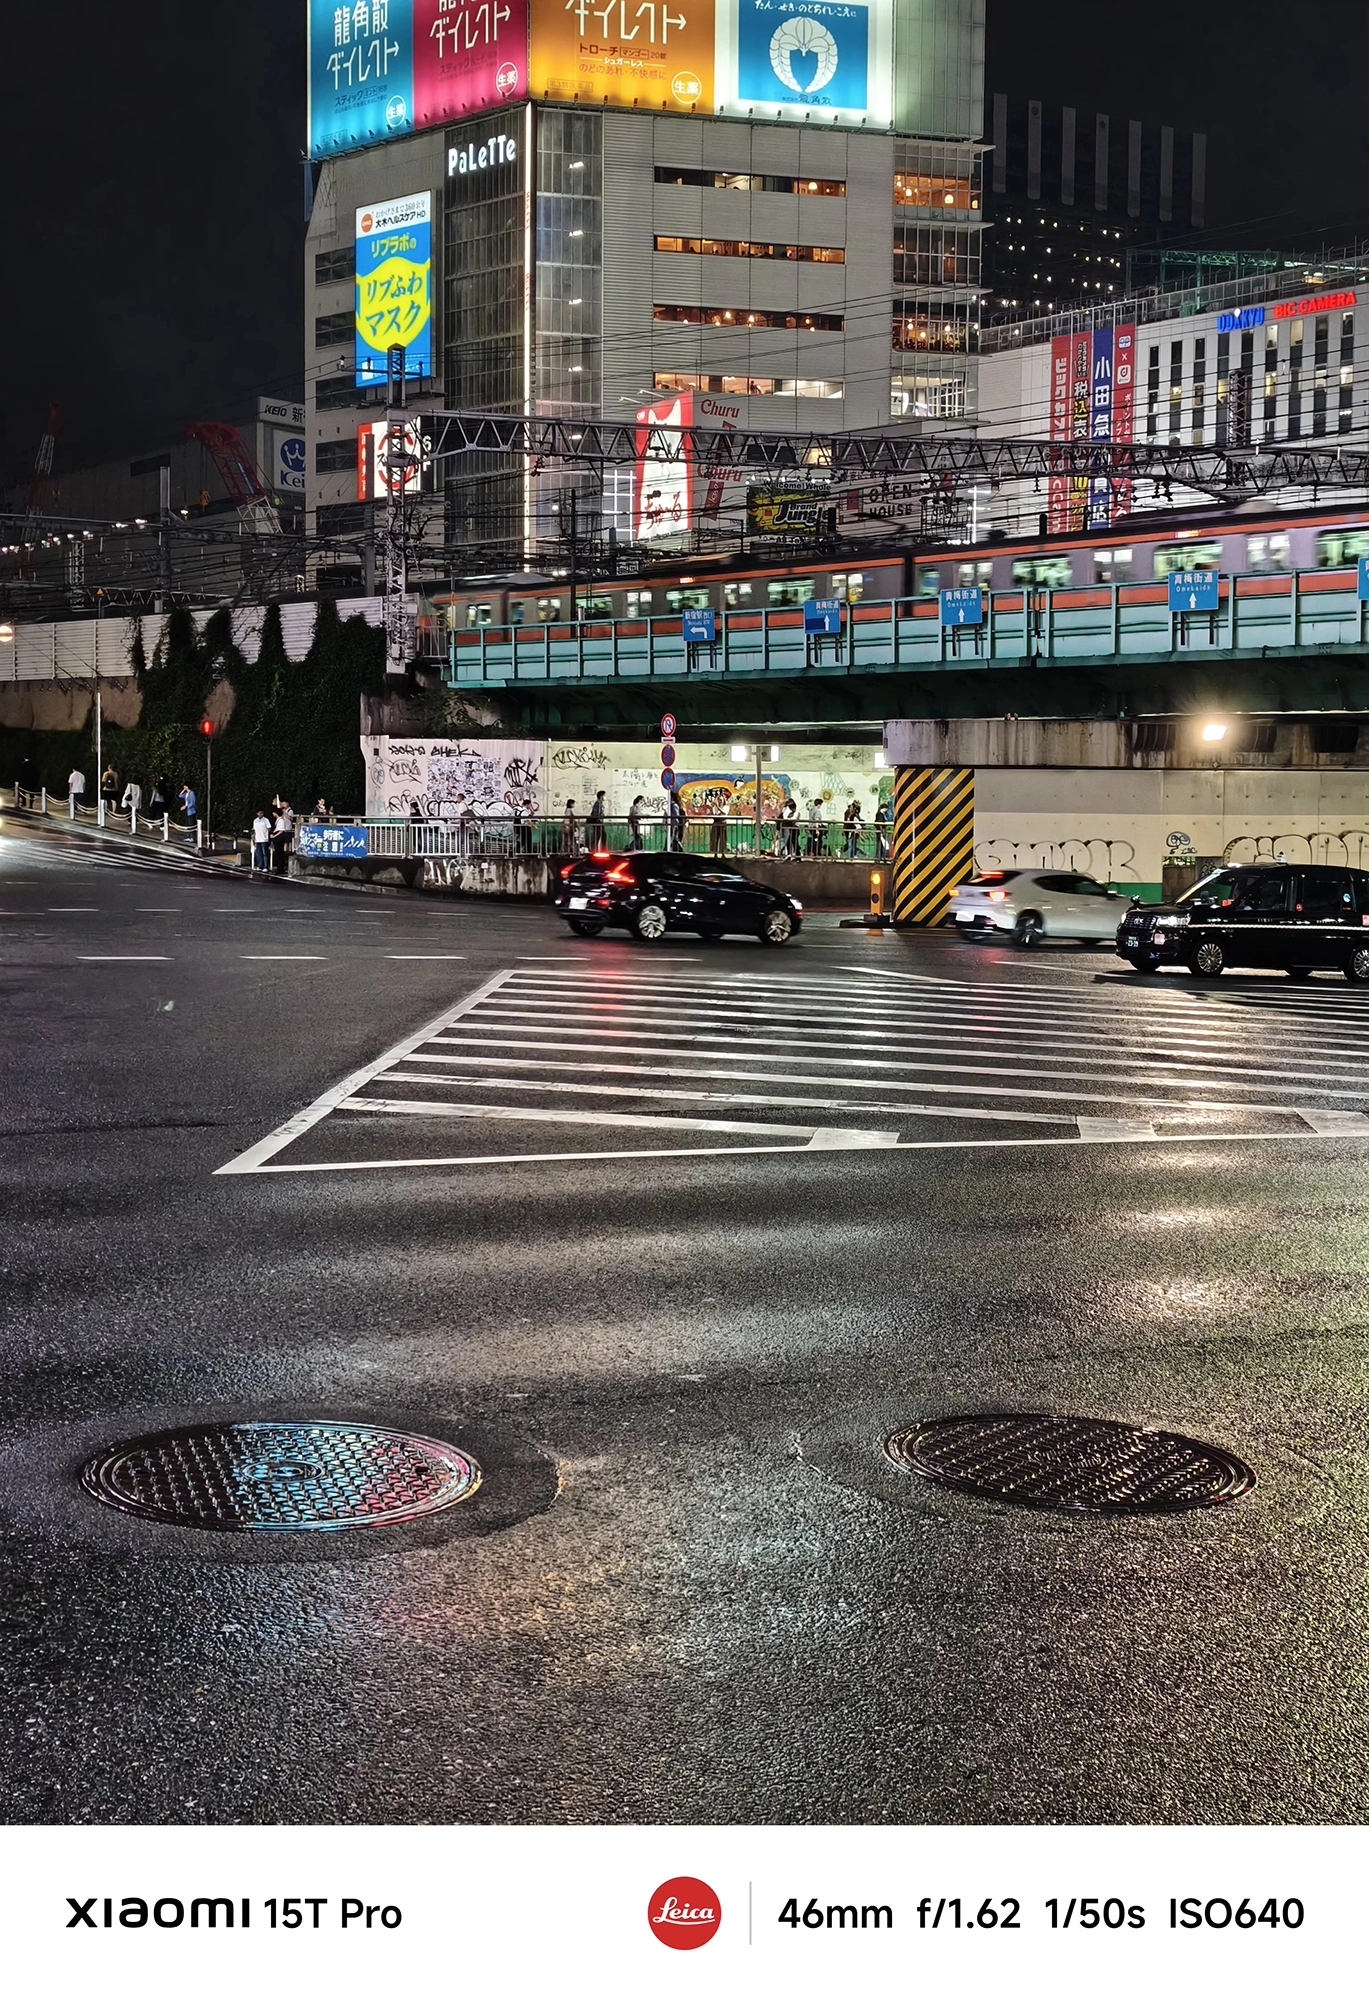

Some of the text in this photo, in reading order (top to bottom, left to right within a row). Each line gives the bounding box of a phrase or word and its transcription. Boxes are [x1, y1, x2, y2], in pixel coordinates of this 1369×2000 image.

[334, 0, 389, 47] 龍角散
[579, 43, 619, 55] トローチ
[603, 57, 644, 68] シュガーレス
[673, 79, 700, 96] 生薬
[1273, 290, 1358, 320] BIC CAMERA
[365, 299, 422, 337] マスク
[264, 404, 287, 417] KEIO
[701, 399, 740, 419] Churu
[1174, 572, 1213, 584] 青梅街道
